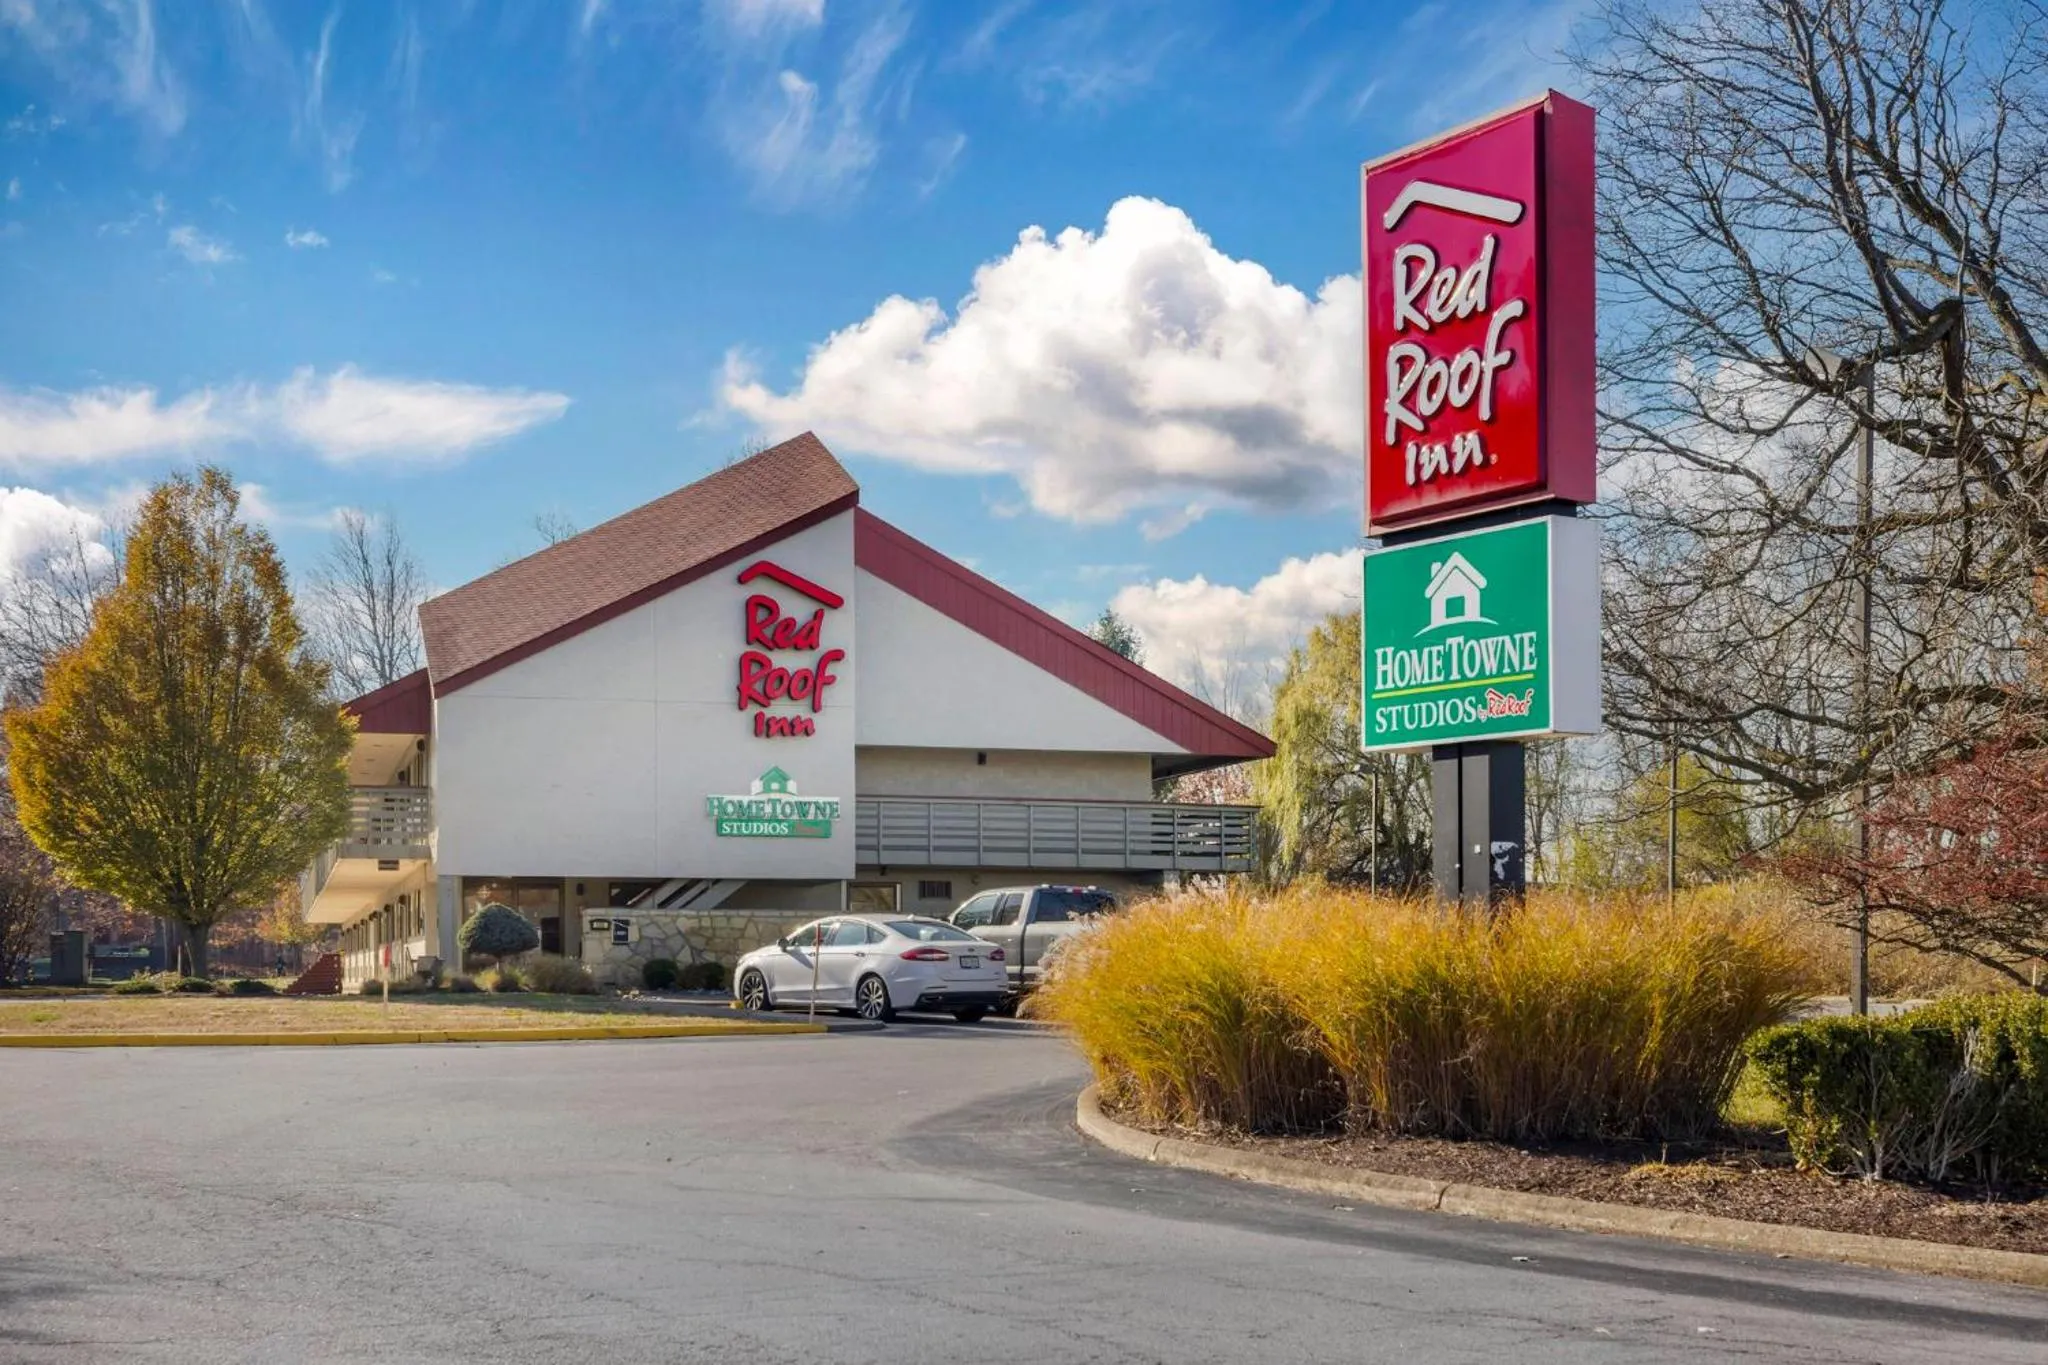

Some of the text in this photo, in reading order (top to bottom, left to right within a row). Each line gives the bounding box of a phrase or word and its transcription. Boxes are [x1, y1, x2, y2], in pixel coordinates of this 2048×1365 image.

[1394, 233, 1495, 332] Red
[1385, 299, 1525, 446] Roof
[1405, 430, 1484, 486] Inn
[745, 594, 825, 650] Red
[737, 648, 845, 713] Roof
[754, 711, 815, 738] Inn
[1375, 696, 1477, 733] STUDIOS
[721, 821, 789, 835] STUDIOS
